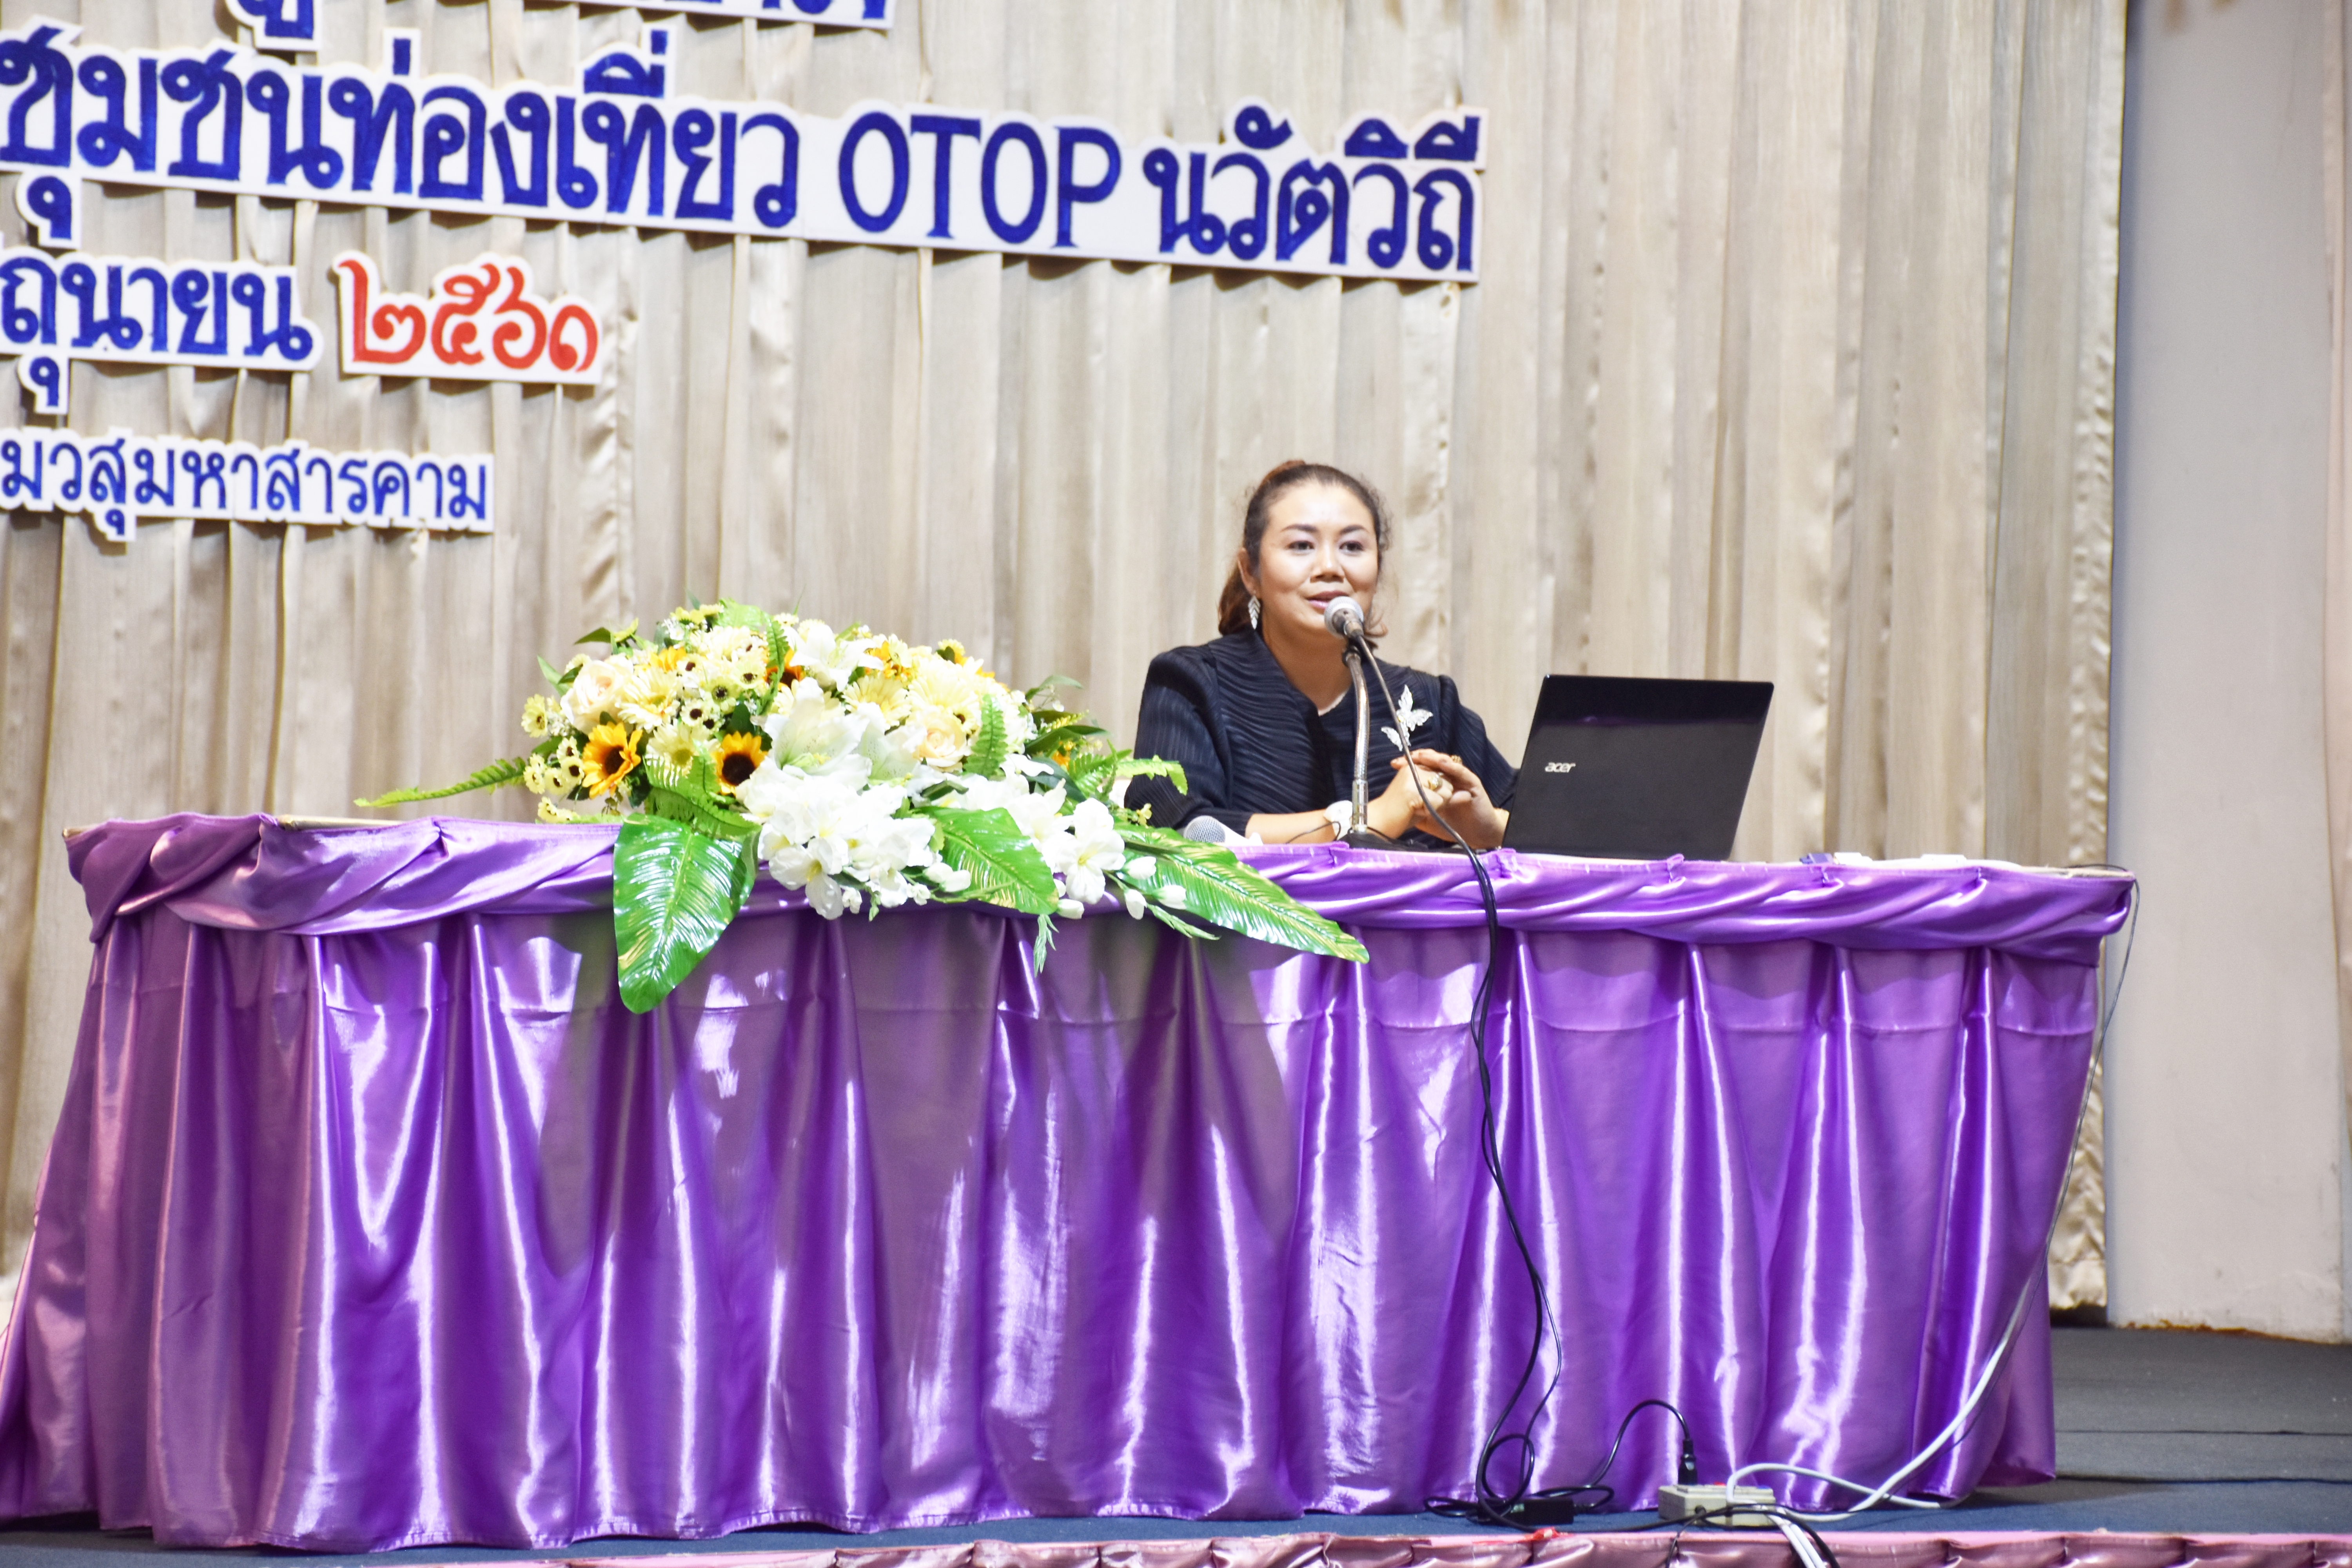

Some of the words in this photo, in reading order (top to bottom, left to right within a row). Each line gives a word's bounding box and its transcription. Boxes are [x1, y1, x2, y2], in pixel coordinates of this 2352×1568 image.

[0, 25, 799, 240] ชุมชนท่องเที่ยว
[839, 111, 1122, 248] OTOP
[1143, 106, 1479, 272] นวัตวิถี
[0, 256, 313, 407] ถุนายน
[339, 260, 598, 372] ๒๕๖๑
[1544, 762, 1576, 773] acer
